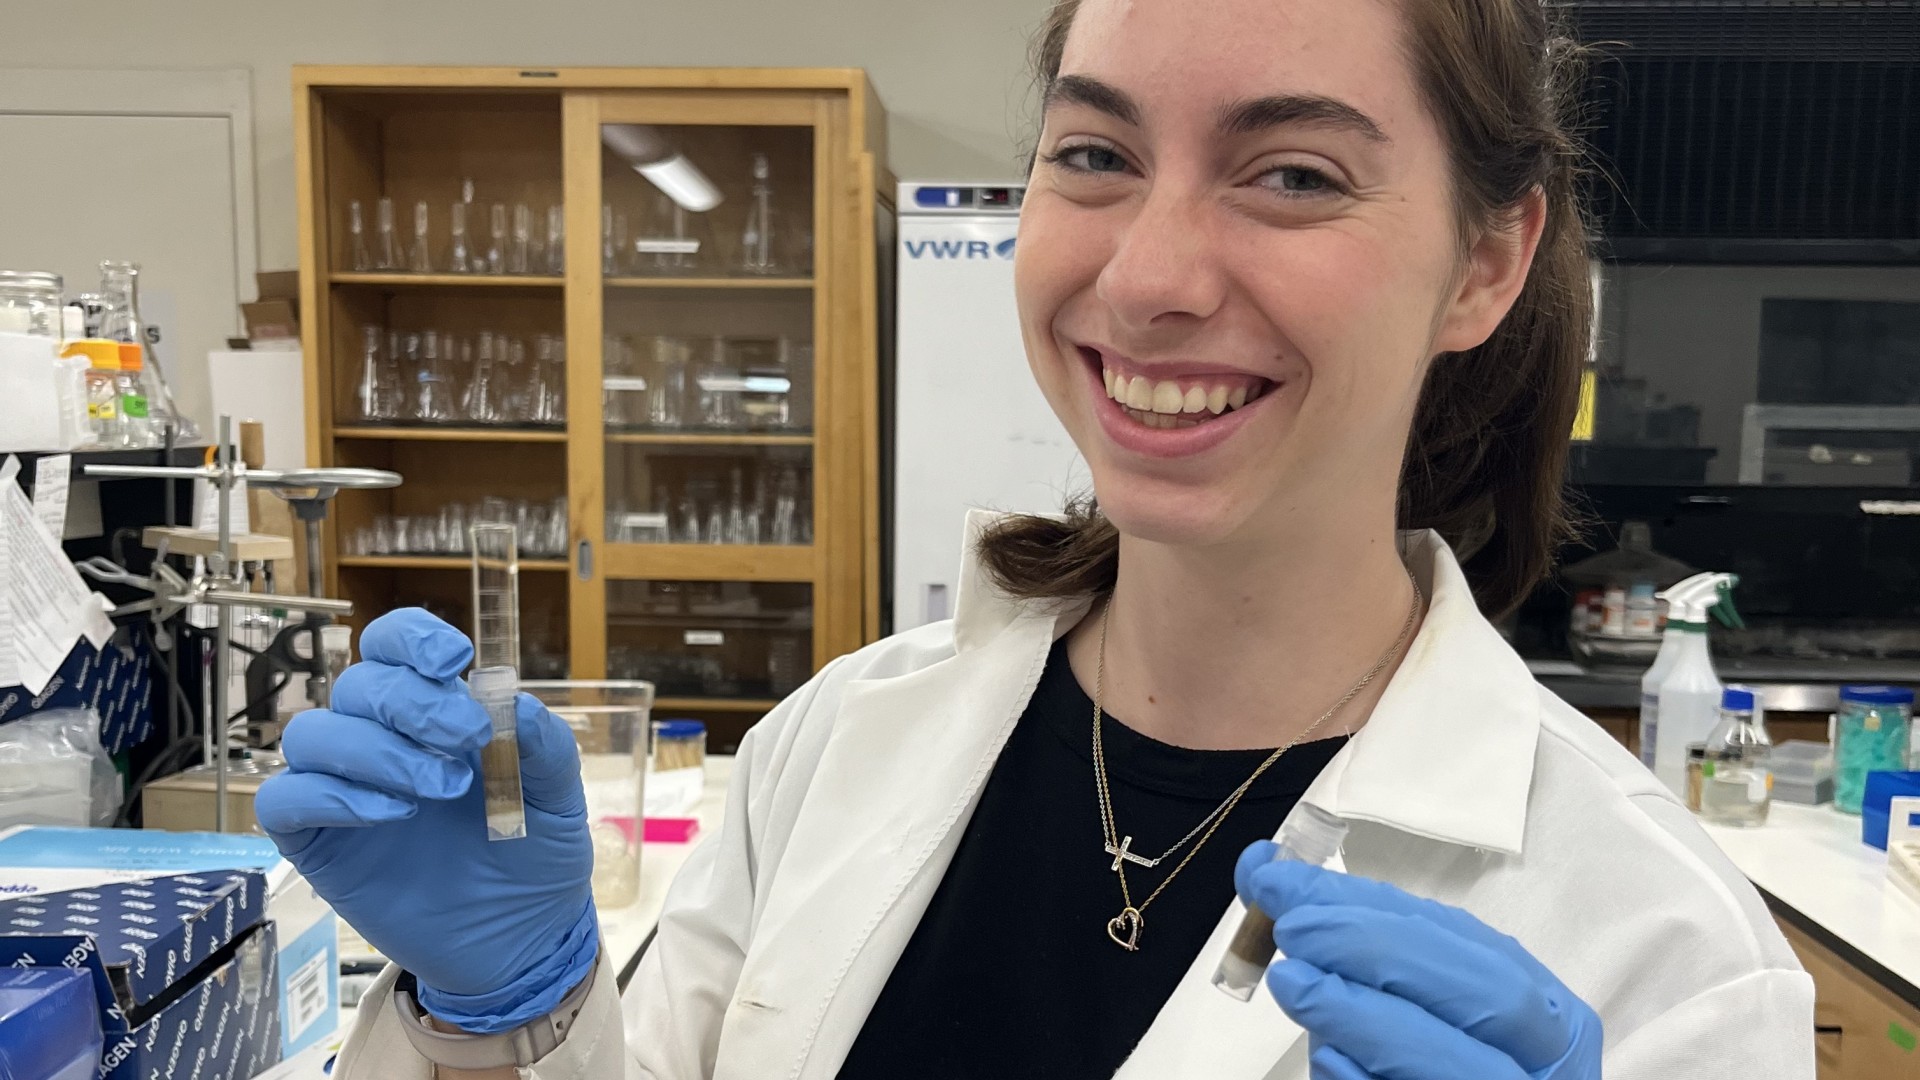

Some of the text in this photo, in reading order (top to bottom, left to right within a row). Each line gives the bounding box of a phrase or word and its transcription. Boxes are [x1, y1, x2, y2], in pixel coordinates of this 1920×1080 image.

[905, 240, 989, 259] VWR
[165, 1019, 188, 1080] QIAGEN
[210, 1001, 231, 1059] QIAGEN
[100, 1036, 137, 1080] AGEN
